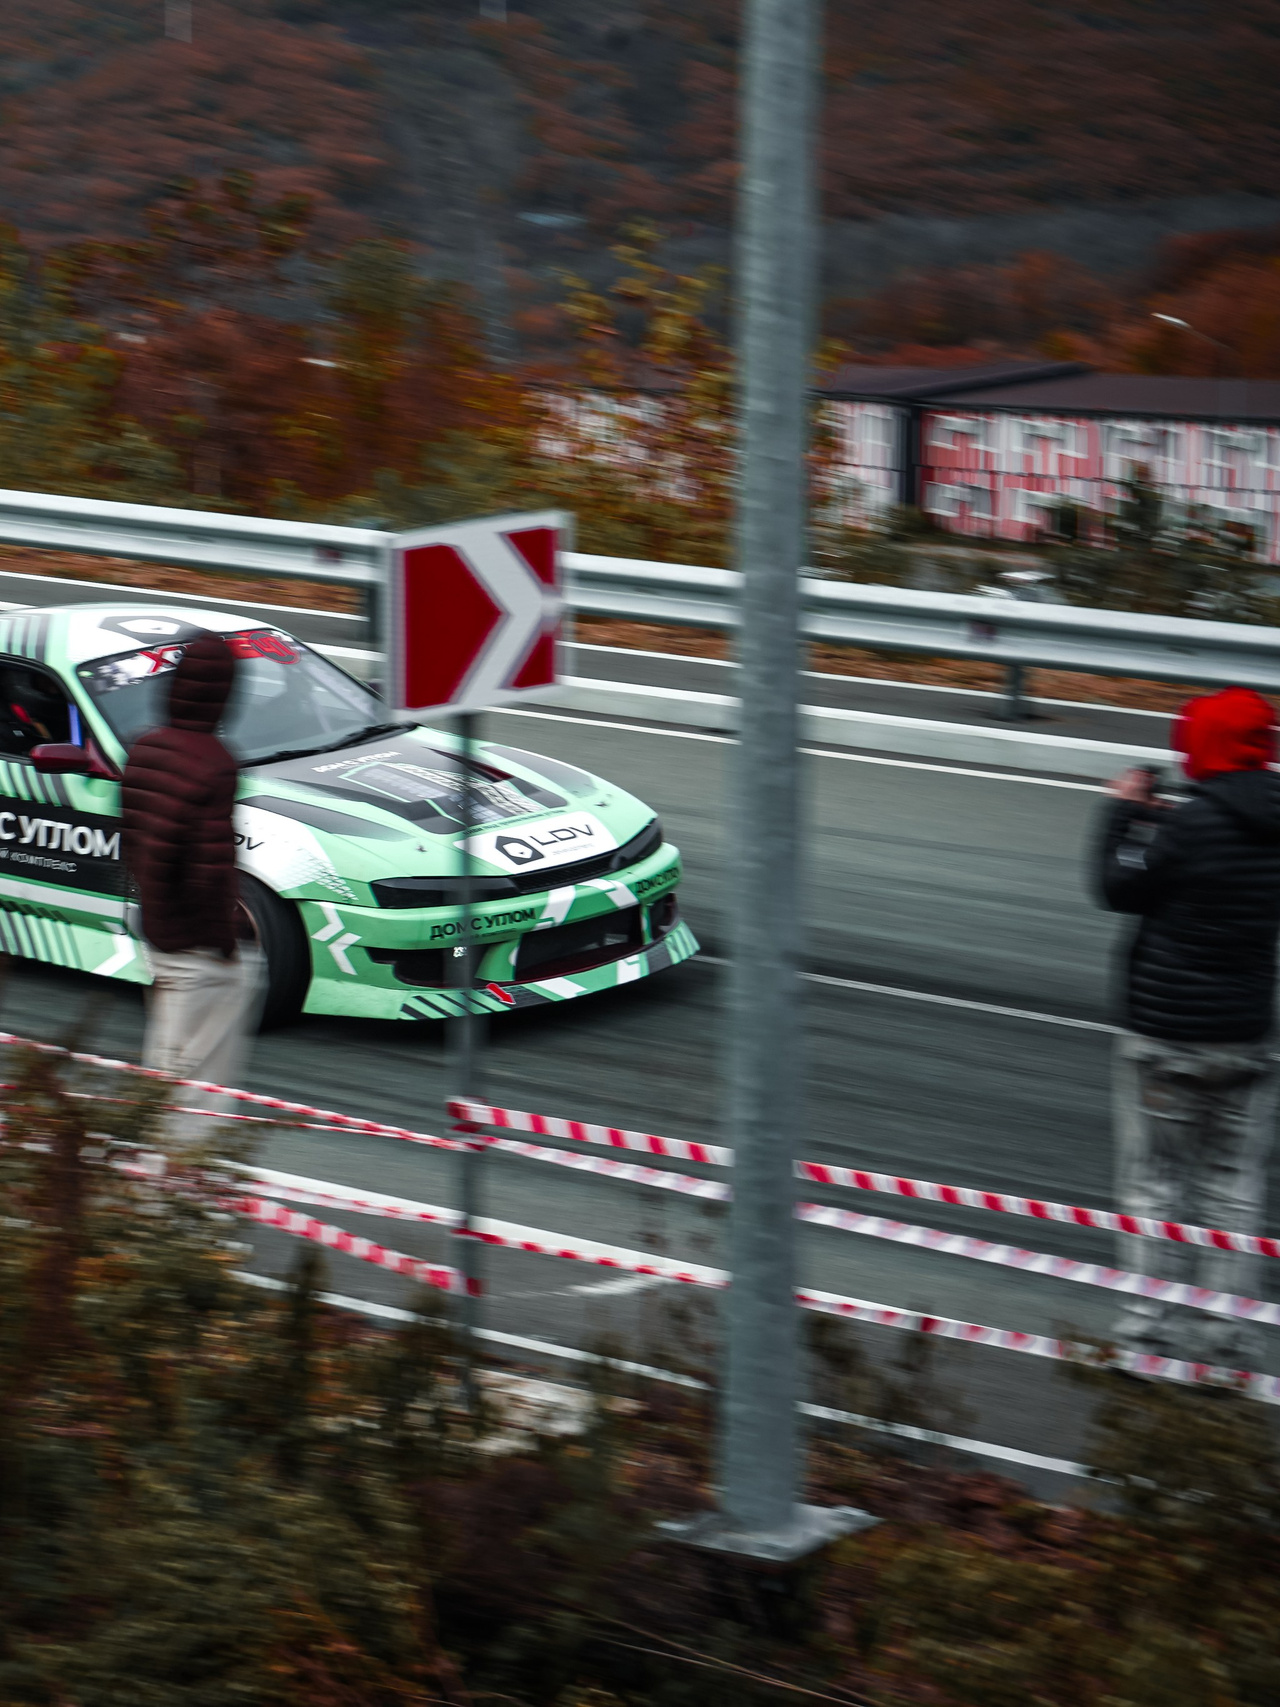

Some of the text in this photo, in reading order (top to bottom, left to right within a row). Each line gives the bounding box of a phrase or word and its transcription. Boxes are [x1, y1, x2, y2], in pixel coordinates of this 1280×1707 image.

[18, 815, 120, 861] УГЛОМ
[530, 824, 594, 846] LDV
[470, 917, 483, 931] С
[483, 907, 536, 929] УГЛОМ
